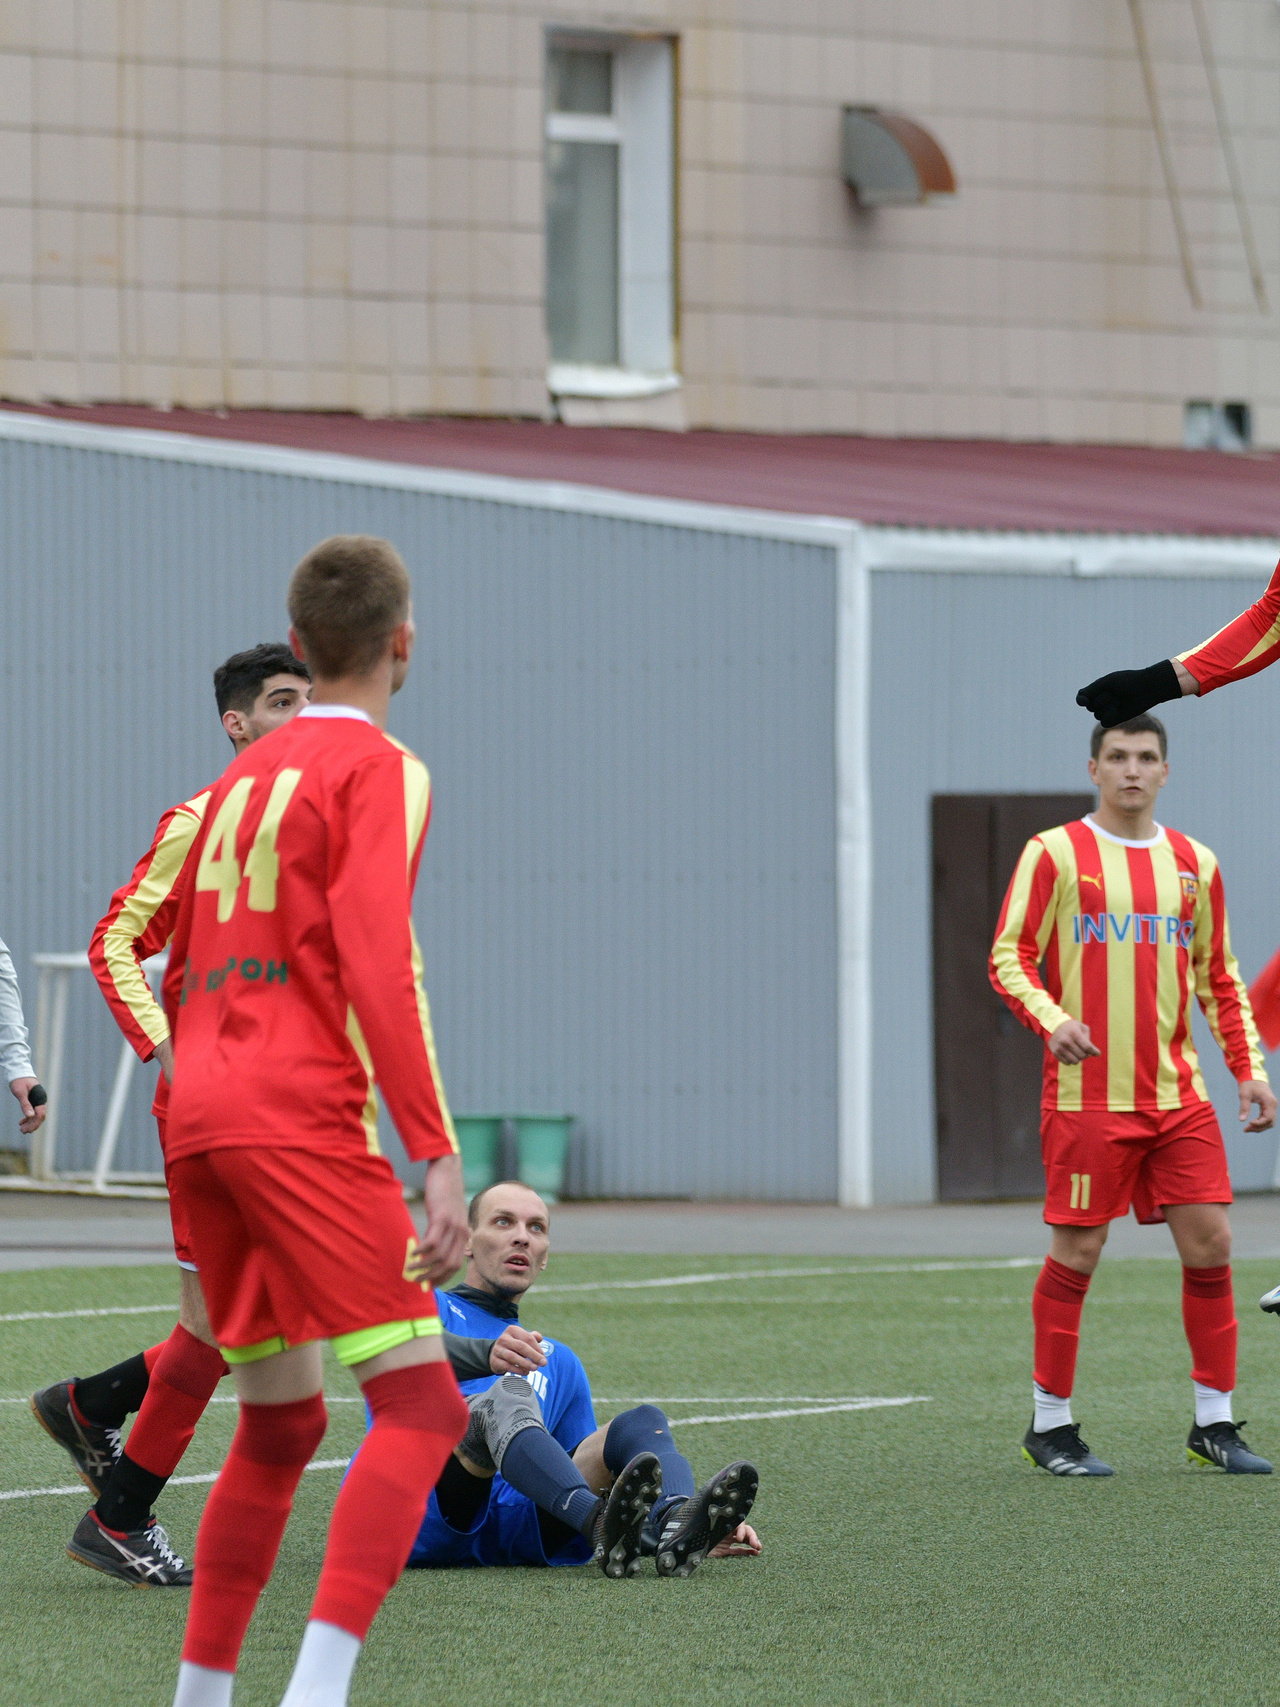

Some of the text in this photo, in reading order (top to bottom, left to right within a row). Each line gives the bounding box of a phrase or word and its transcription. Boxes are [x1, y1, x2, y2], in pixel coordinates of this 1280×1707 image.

[196, 768, 303, 924] 44
[1073, 912, 1195, 949] INVITRO
[1070, 1173, 1091, 1210] 11
